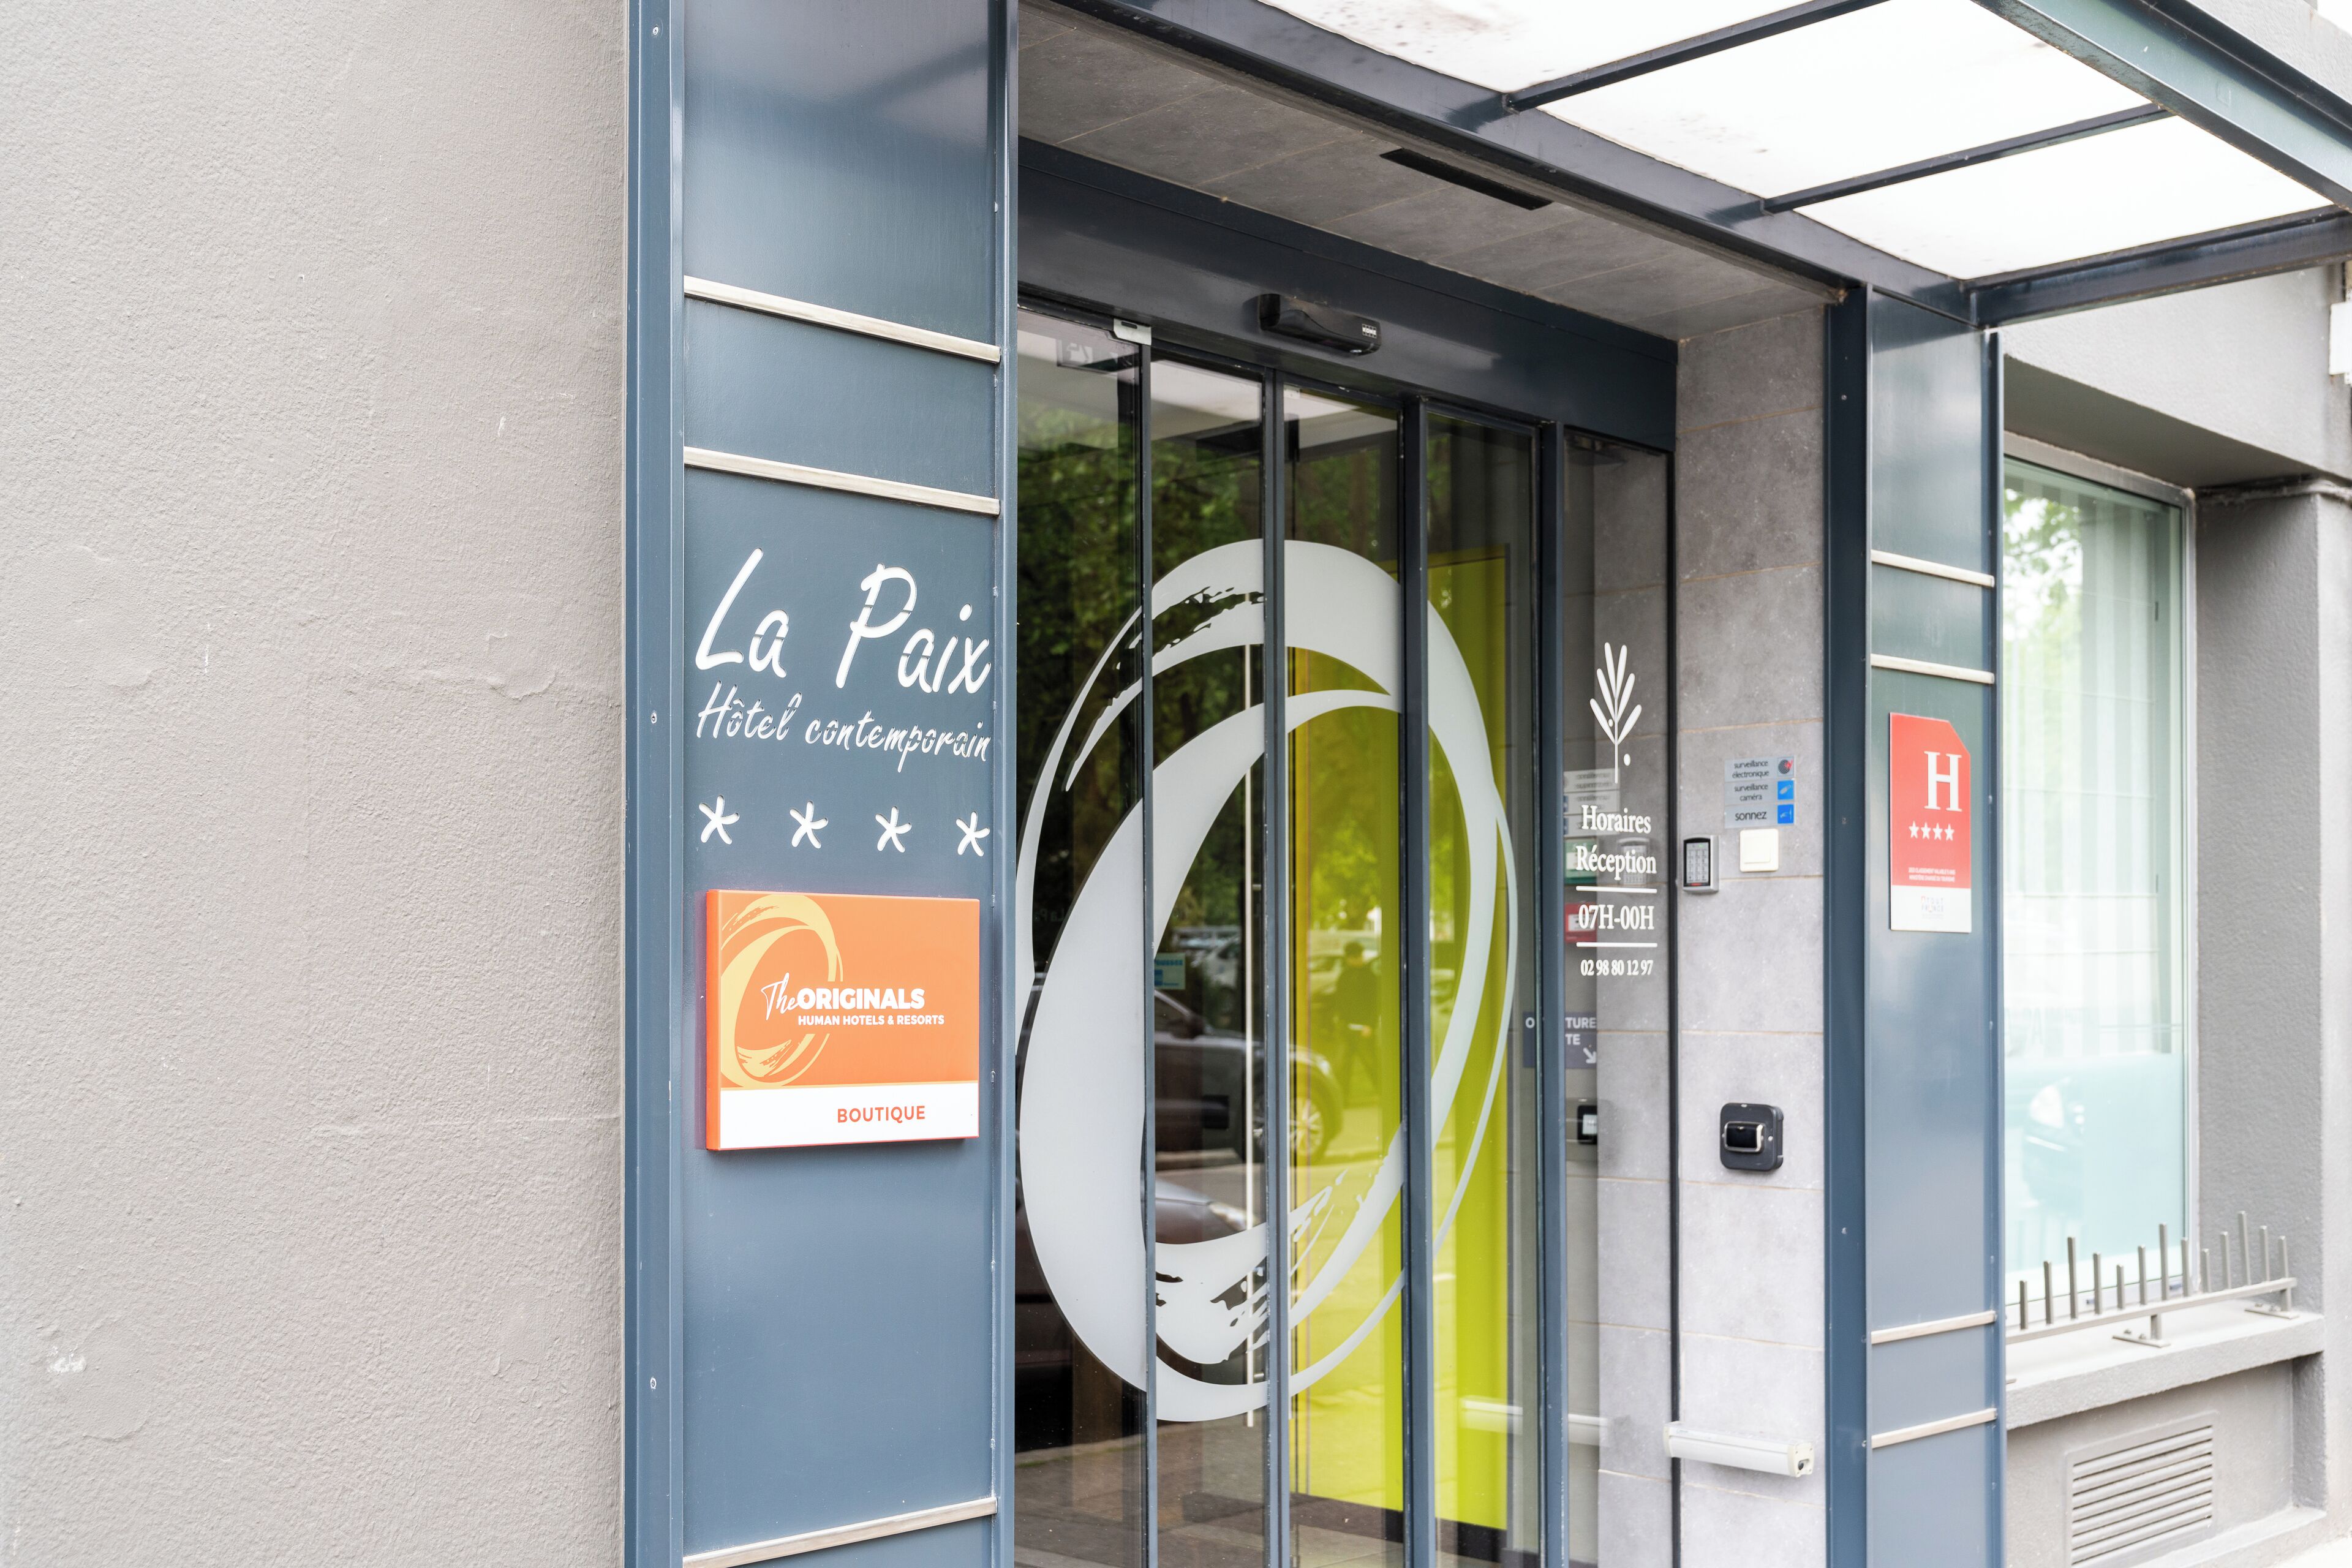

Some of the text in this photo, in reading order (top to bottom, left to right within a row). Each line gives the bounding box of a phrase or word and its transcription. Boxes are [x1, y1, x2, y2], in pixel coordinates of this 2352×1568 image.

[695, 548, 992, 695] La Paix
[696, 680, 991, 773] Hôtel contemporain
[1733, 760, 1768, 769] surveillance
[1734, 783, 1768, 792] surveillance
[1923, 751, 1962, 812] H
[1581, 804, 1652, 834] Horaires
[1735, 811, 1768, 821] sonnez
[1575, 844, 1657, 881] Réception
[1578, 904, 1655, 930] 07H-00H
[1580, 959, 1654, 976] 02 98 80 12 97
[761, 971, 925, 1021] The ORIGINALS
[798, 1014, 945, 1026] HUMAN HOTELS & RESORTS
[837, 1105, 926, 1124] BOUTIQUE
